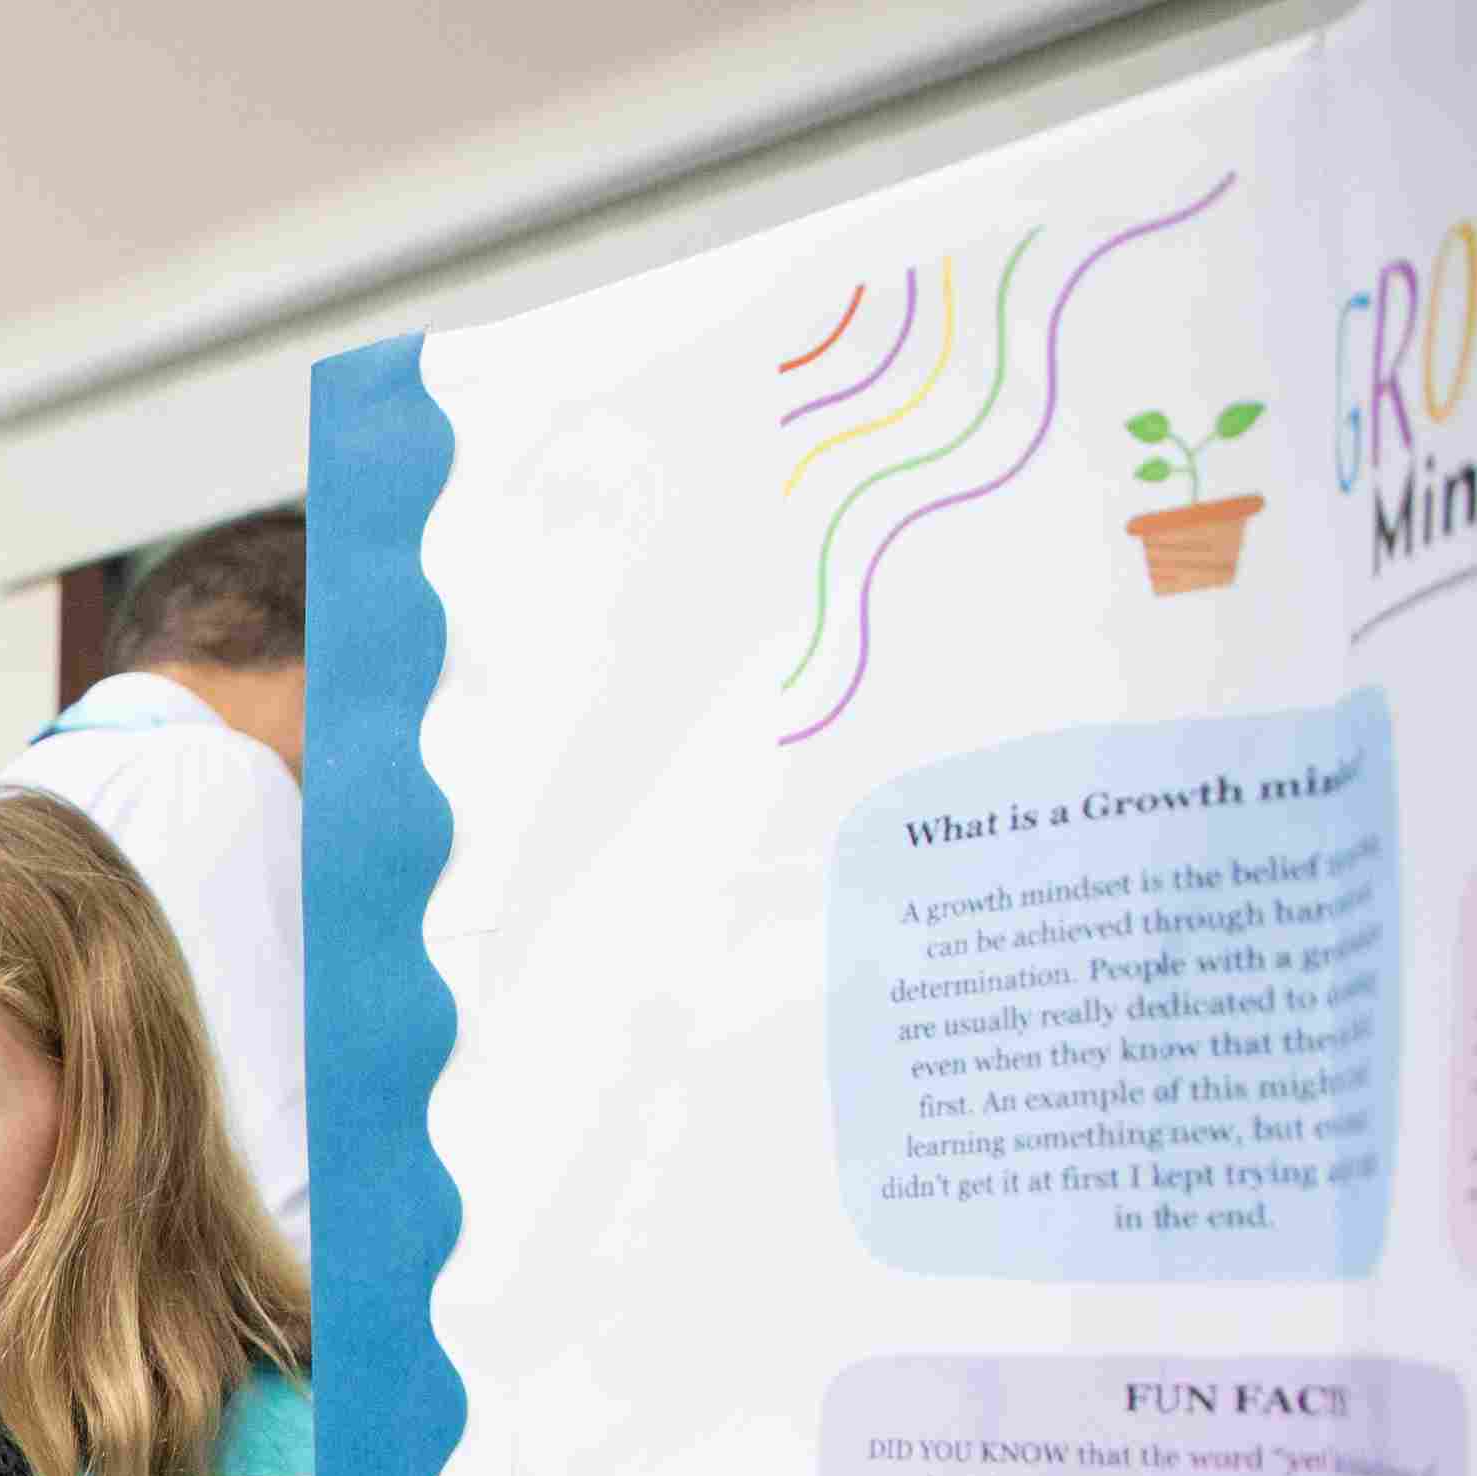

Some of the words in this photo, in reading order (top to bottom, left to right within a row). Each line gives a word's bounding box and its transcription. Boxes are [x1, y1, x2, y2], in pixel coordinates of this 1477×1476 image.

[906, 813, 998, 847] What
[1010, 802, 1038, 832] is
[1050, 804, 1069, 826] a
[1082, 774, 1245, 820] Growth
[901, 901, 919, 924] A
[926, 885, 1013, 927] growth
[1019, 874, 1130, 908] mindset
[1142, 868, 1163, 892] is
[1174, 864, 1222, 890] the
[1231, 852, 1321, 885] belief
[927, 937, 968, 959] can
[977, 928, 1006, 952] be
[1011, 910, 1133, 948] achieved
[1143, 901, 1265, 936] through
[890, 964, 1079, 1003] determination.
[1088, 948, 1186, 985] People
[1198, 944, 1266, 971] with
[1275, 951, 1293, 970] a
[897, 1021, 937, 1042] are
[944, 1006, 1031, 1036] usually
[1041, 996, 1115, 1027] really
[1126, 985, 1275, 1021] dedicated
[1286, 988, 1319, 1010] to
[911, 1055, 967, 1079] even
[974, 1046, 1042, 1072] when
[1050, 1041, 1111, 1067] they
[1121, 1035, 1198, 1061] know
[1210, 1030, 1272, 1056] that
[919, 1093, 975, 1119] first.
[983, 1090, 1017, 1113] An
[1024, 1079, 1144, 1113] example
[1153, 1079, 1180, 1101] of
[1190, 1074, 1248, 1101] this
[906, 1130, 1006, 1159] learning
[1012, 1120, 1165, 1153] something
[1170, 1122, 1244, 1145] new,
[1254, 1113, 1304, 1140] but
[881, 1172, 951, 1201] didn't
[958, 1173, 995, 1202] get
[1002, 1168, 1019, 1194] it
[1028, 1170, 1052, 1192] at
[1062, 1164, 1119, 1190] first
[1129, 1164, 1141, 1189] I
[1153, 1164, 1215, 1197] kept
[1227, 1155, 1320, 1191] trying
[1114, 1205, 1142, 1230] in
[1153, 1202, 1199, 1230] the
[1207, 1201, 1279, 1230] end.
[1126, 1383, 1217, 1415] FUN
[868, 1439, 914, 1461] DID
[918, 1440, 972, 1464] YOU
[980, 1440, 1069, 1465] KNOW
[1078, 1441, 1131, 1468] that
[1142, 1444, 1179, 1467] the
[1190, 1444, 1264, 1472] word
